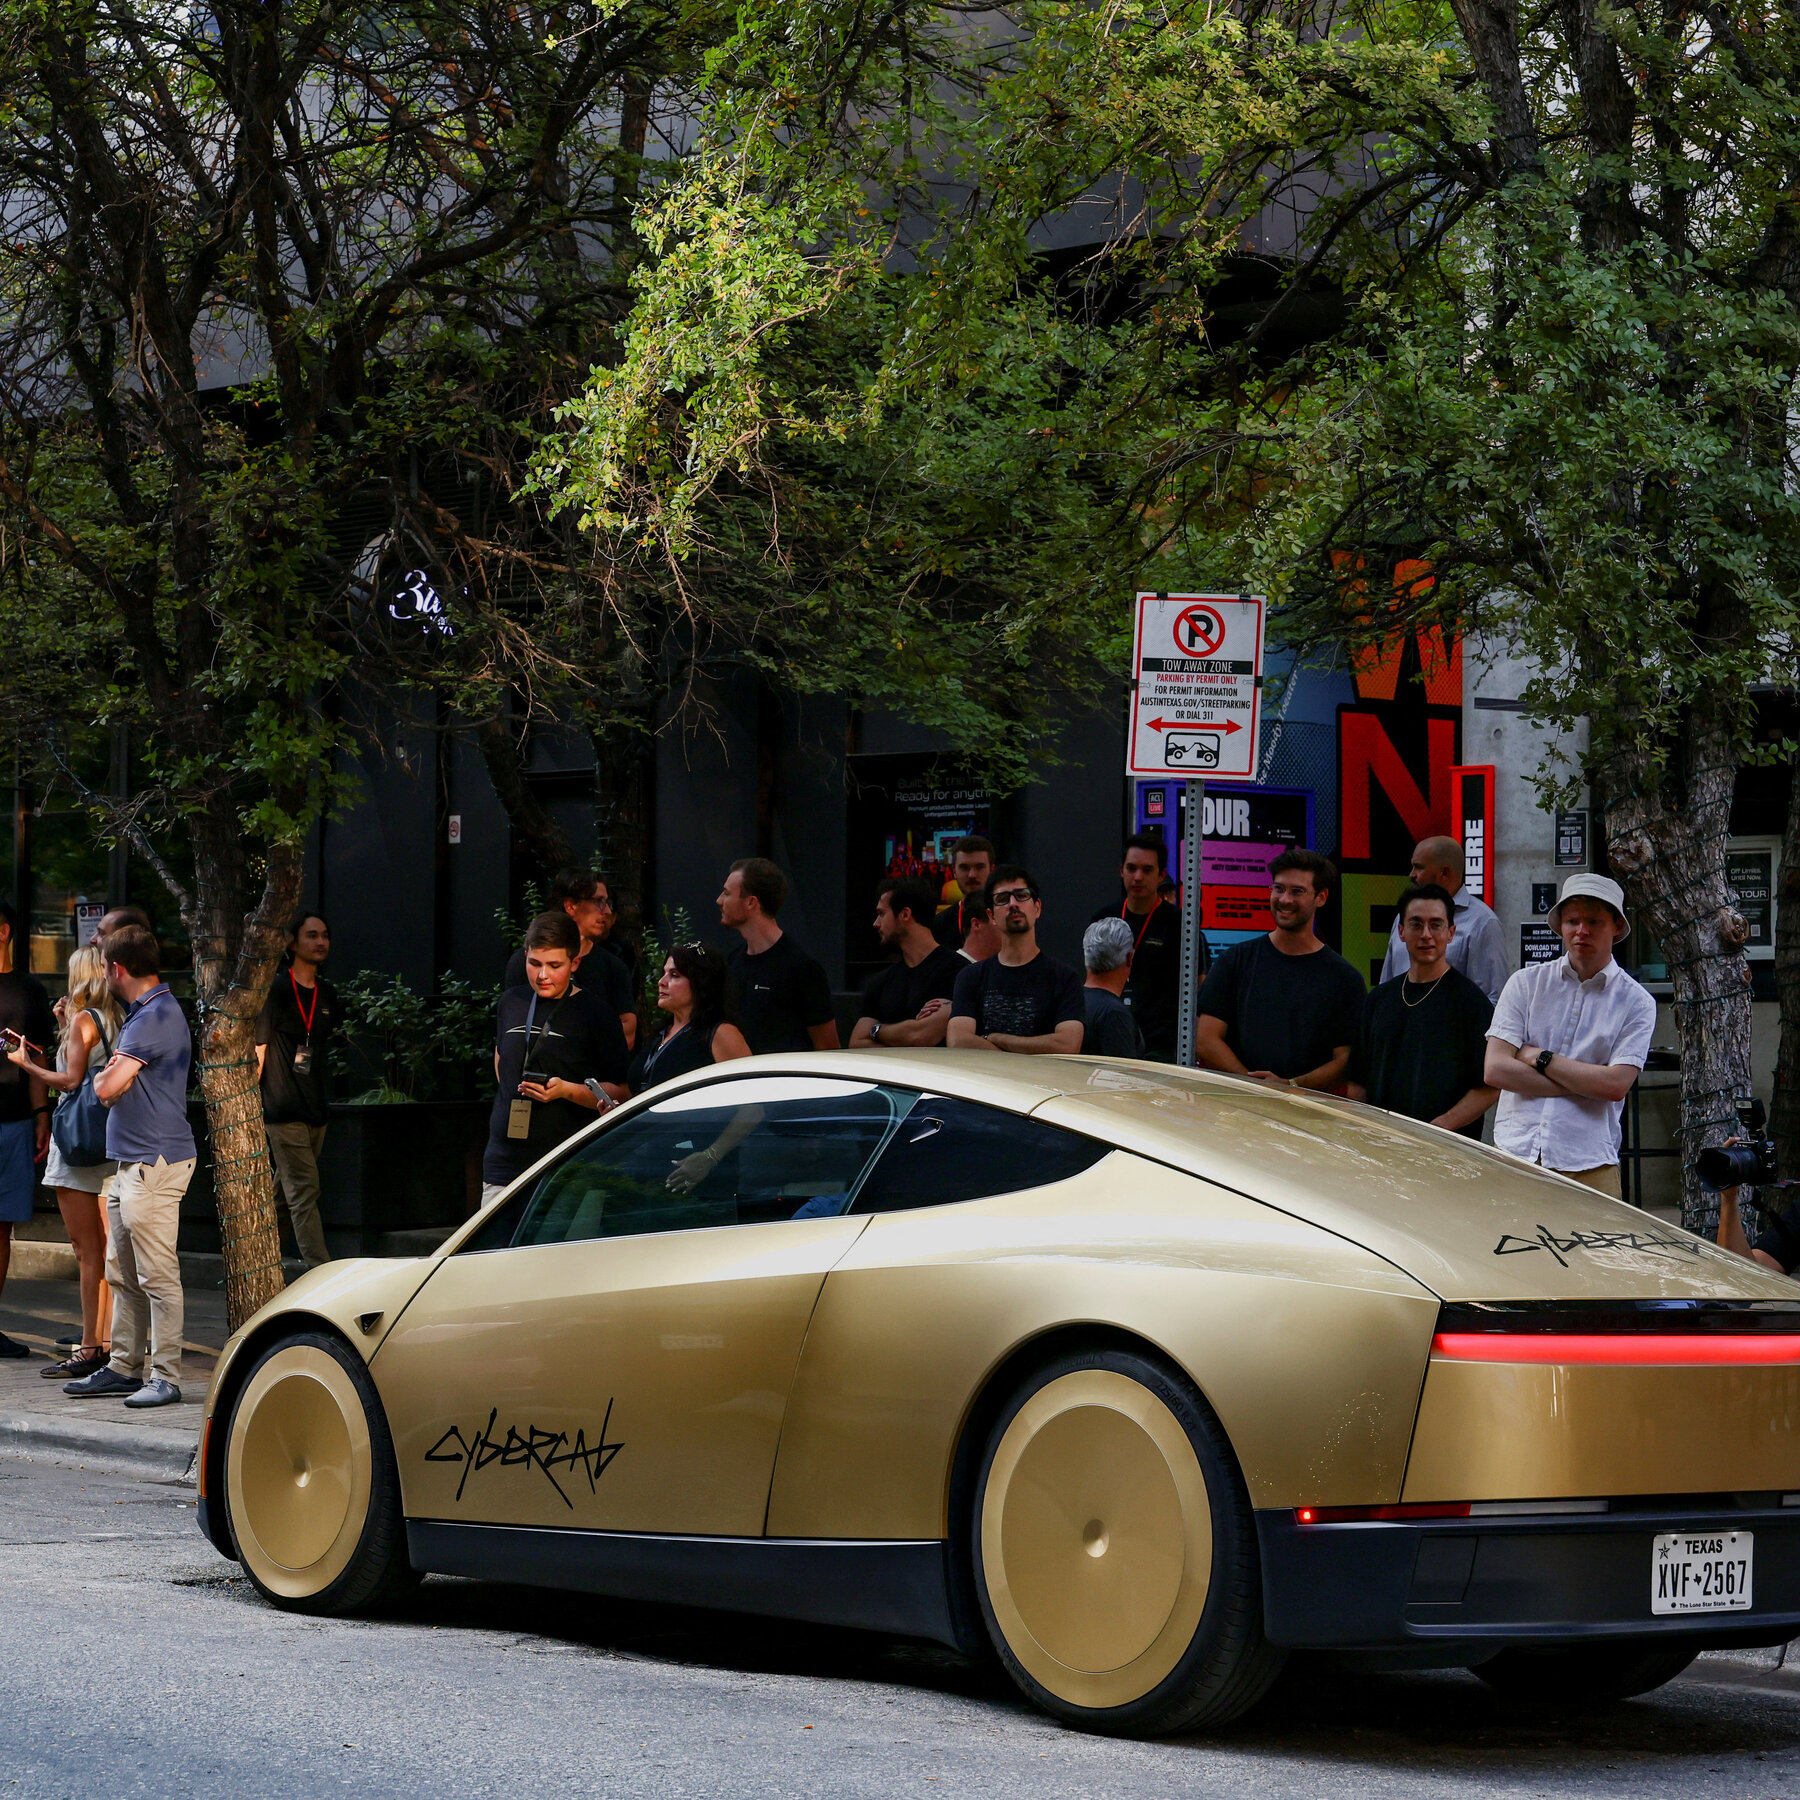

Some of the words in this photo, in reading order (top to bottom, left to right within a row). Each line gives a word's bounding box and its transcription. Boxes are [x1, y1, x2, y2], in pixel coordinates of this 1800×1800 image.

[1162, 659, 1182, 671] TOW
[1183, 660, 1208, 672] AWAY
[1209, 661, 1233, 673] ZONE
[1156, 673, 1185, 683] PARKING
[1186, 674, 1195, 683] BY
[1195, 675, 1220, 684] PERMIT
[1220, 676, 1238, 685] ONLY
[1154, 685, 1168, 694] FOR
[1169, 686, 1193, 695] PERMIT
[1193, 687, 1238, 697] INFORMATION
[1140, 697, 1251, 709] AUSTINTEXAS.GOV/STREETPARKING
[1175, 710, 1185, 719] OR
[1186, 710, 1201, 720] DIAL
[1202, 711, 1214, 720] 311
[895, 790, 930, 802] Ready
[933, 789, 950, 800] for
[1150, 794, 1161, 803] ACL
[1180, 796, 1250, 837] OUR
[1464, 819, 1484, 895] HERE
[1740, 890, 1767, 898] TOUR
[1685, 1539, 1723, 1555] TEXAS
[1658, 1563, 1692, 1598] XVF
[1702, 1560, 1747, 1596] 2567
